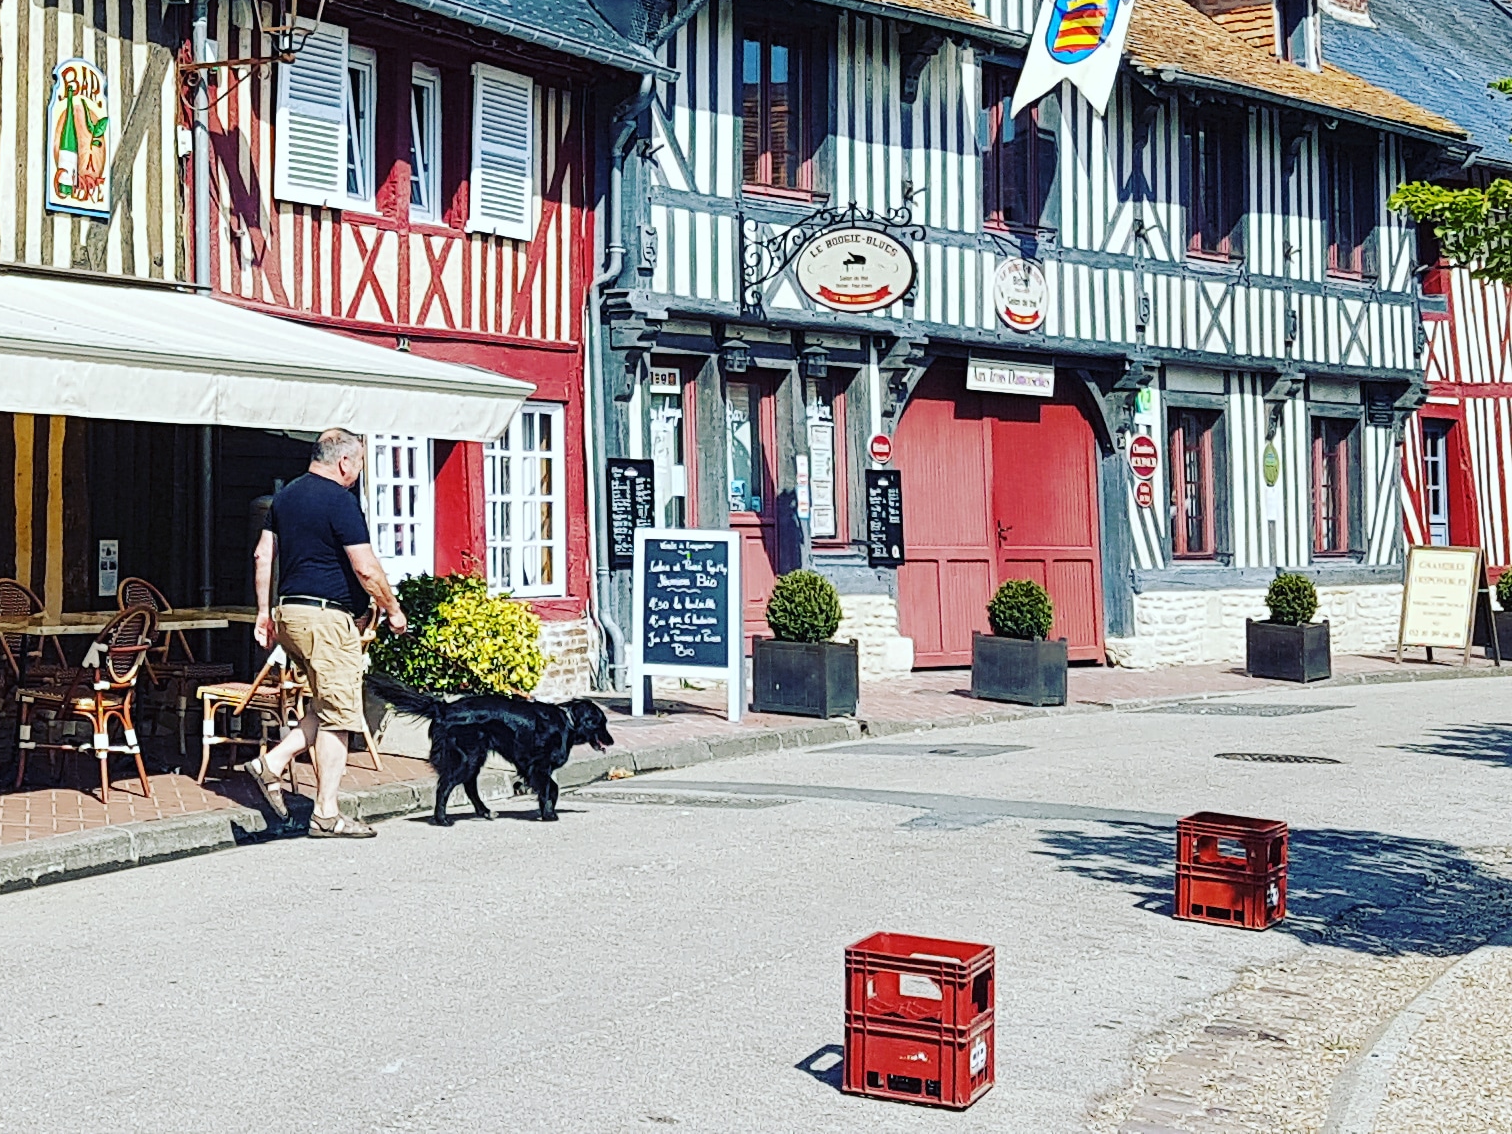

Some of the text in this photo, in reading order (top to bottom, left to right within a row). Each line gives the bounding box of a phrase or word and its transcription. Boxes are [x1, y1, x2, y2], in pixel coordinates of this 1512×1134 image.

[58, 66, 102, 108] BAR
[809, 234, 899, 258] LE BOOGIE-BLUES
[696, 573, 718, 587] Bio
